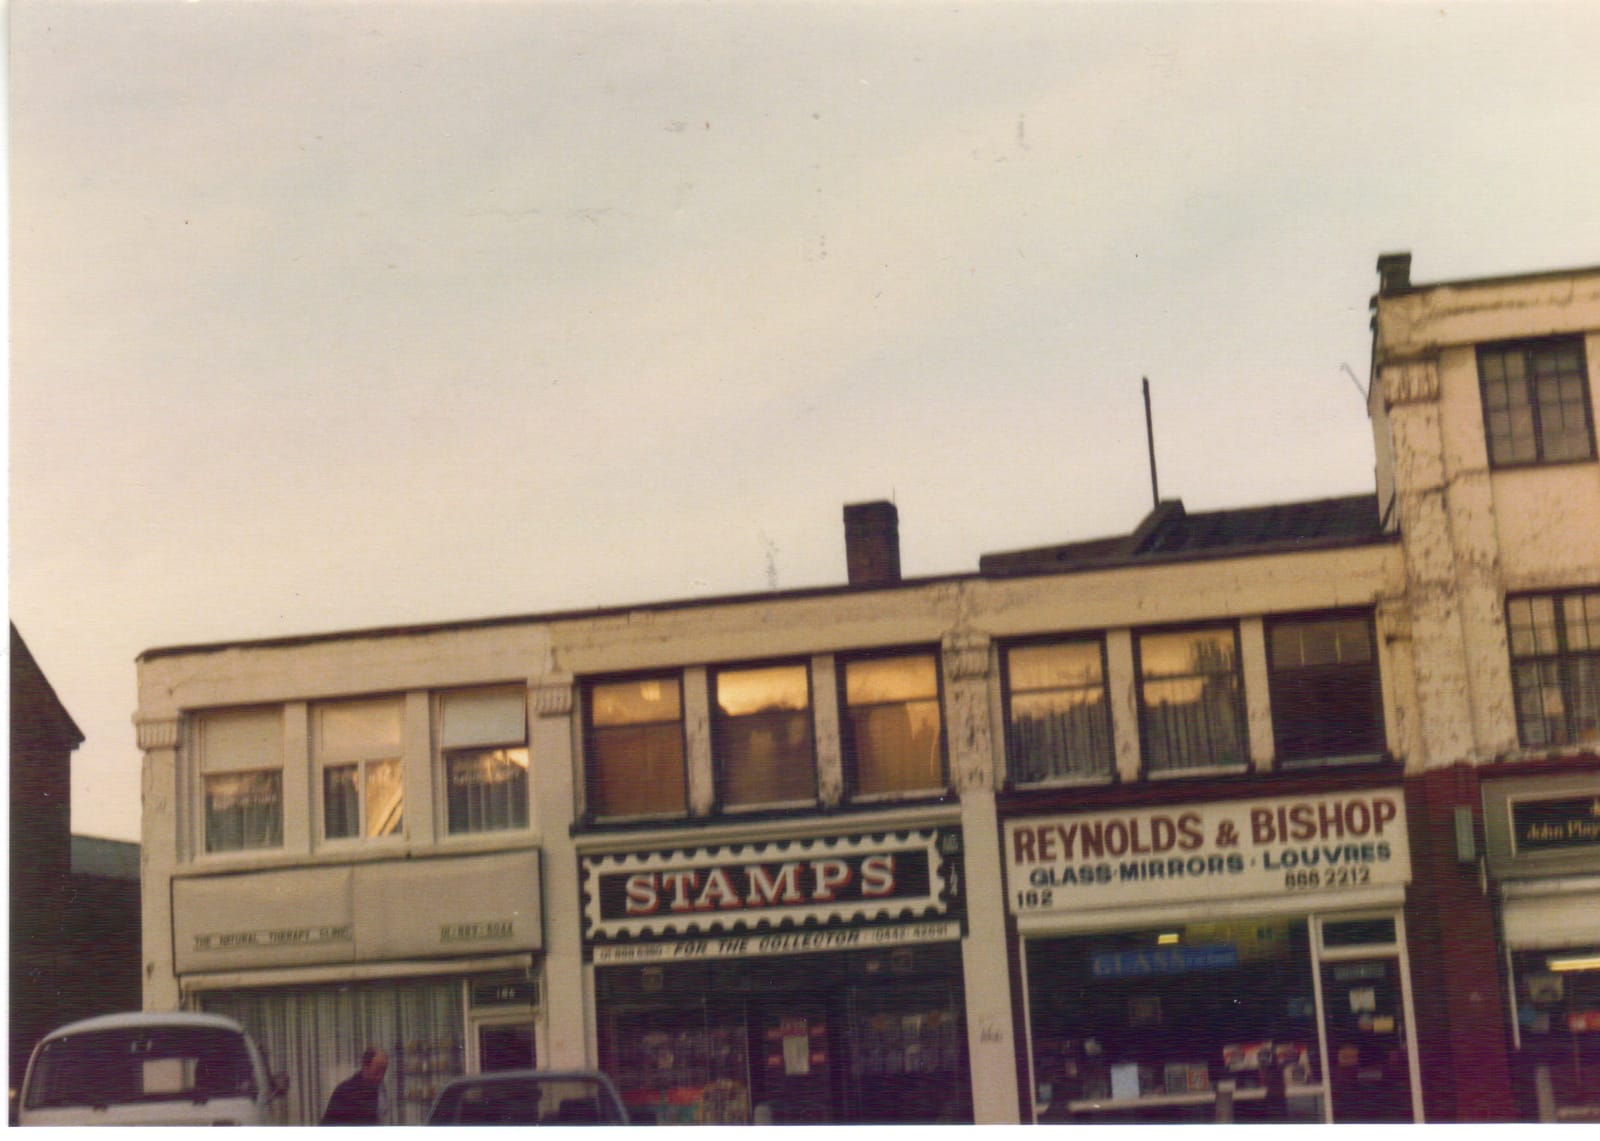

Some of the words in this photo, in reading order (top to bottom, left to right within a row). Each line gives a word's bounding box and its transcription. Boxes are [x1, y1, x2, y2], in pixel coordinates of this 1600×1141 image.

[1012, 811, 1205, 866] REYNOLDS
[1216, 819, 1240, 850] &
[1250, 798, 1398, 846] BISHOP
[625, 855, 896, 916] STAMPS
[1029, 863, 1112, 888] GLASS
[1119, 852, 1245, 881] MIRRORS
[1263, 840, 1393, 870] LOUVRES
[673, 941, 707, 956] FOR
[718, 937, 748, 953] THE
[759, 930, 860, 951] COLLECTOR
